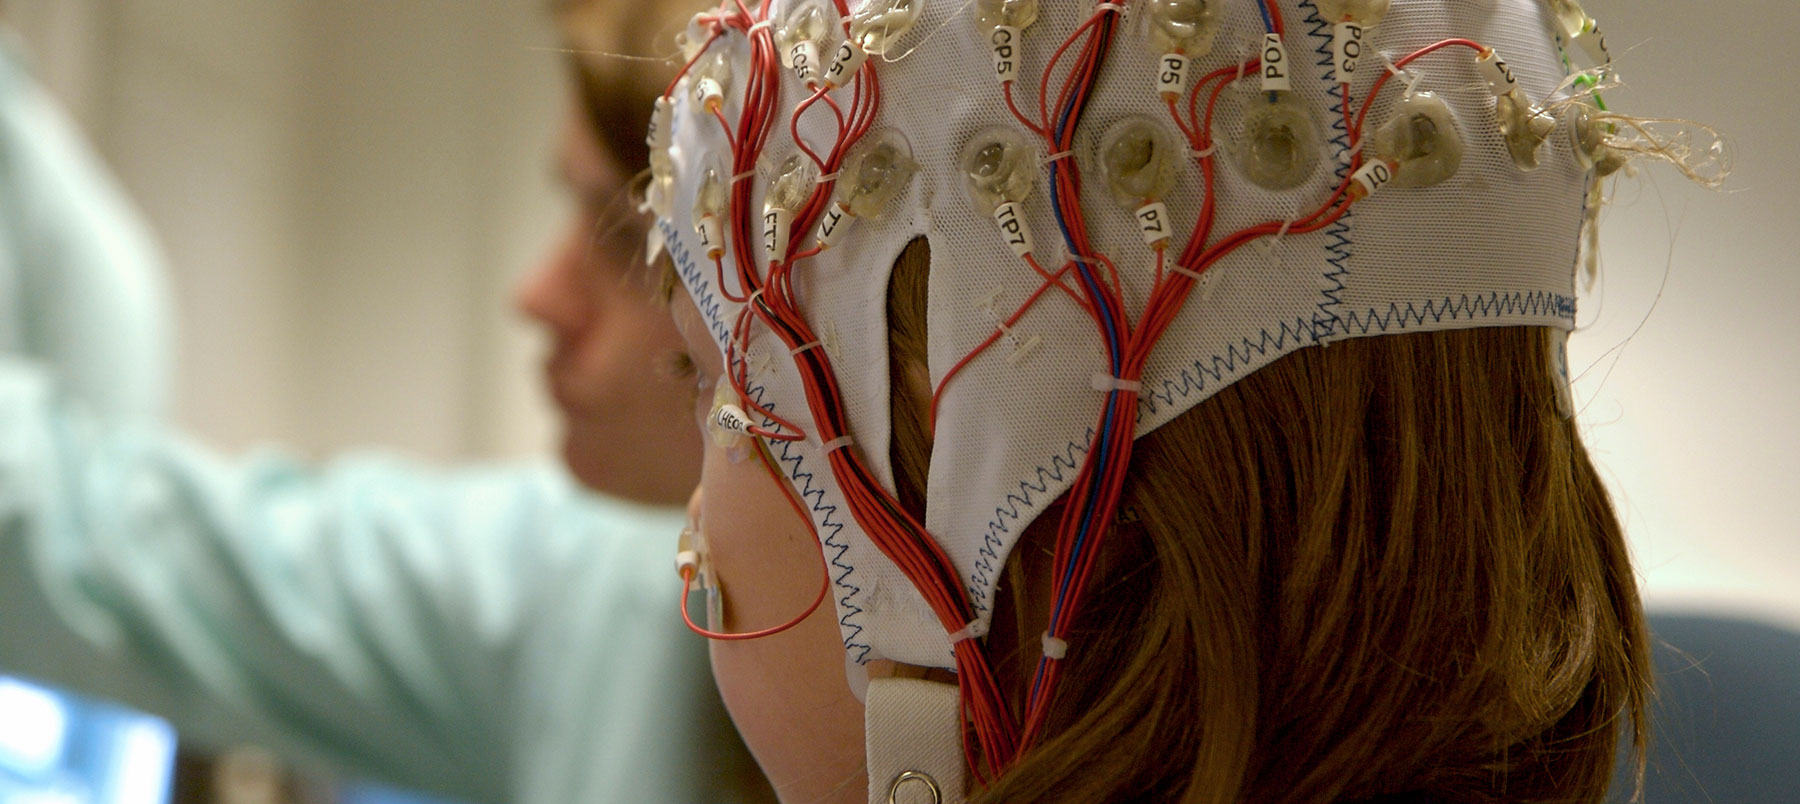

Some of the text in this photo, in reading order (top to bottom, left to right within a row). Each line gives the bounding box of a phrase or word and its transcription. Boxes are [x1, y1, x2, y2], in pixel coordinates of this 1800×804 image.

[791, 44, 809, 78] FC5
[829, 45, 852, 75] C5
[992, 29, 1012, 75] CP5
[1161, 58, 1182, 85] P5
[764, 212, 777, 251] FT7
[822, 212, 842, 237] T7
[998, 207, 1025, 245] TP7
[1140, 210, 1162, 232] P7
